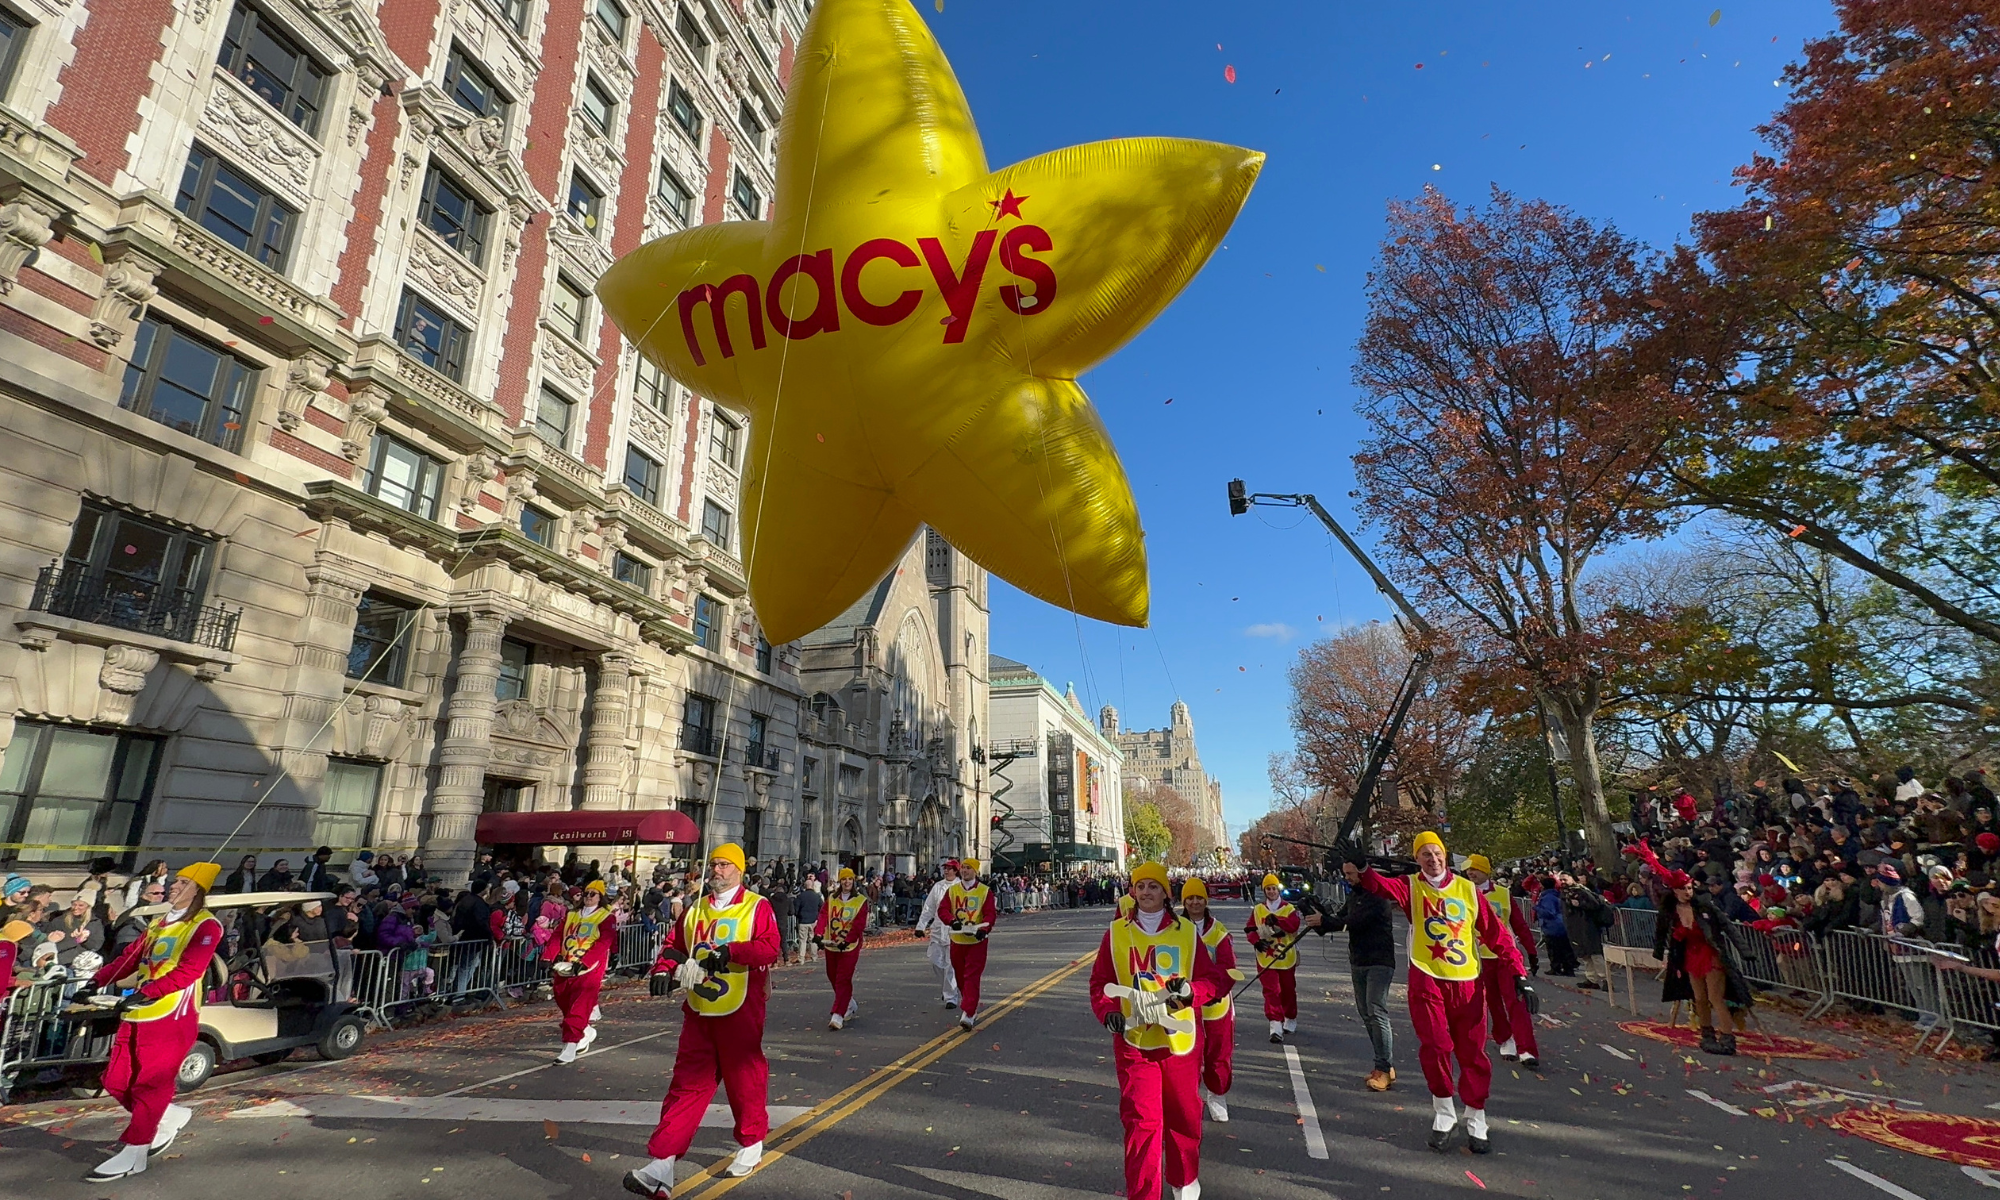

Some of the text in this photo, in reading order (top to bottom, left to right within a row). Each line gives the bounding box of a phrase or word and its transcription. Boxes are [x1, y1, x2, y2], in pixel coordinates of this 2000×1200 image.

[552, 829, 632, 841] Kenilworth 151
[665, 830, 675, 840] 151
